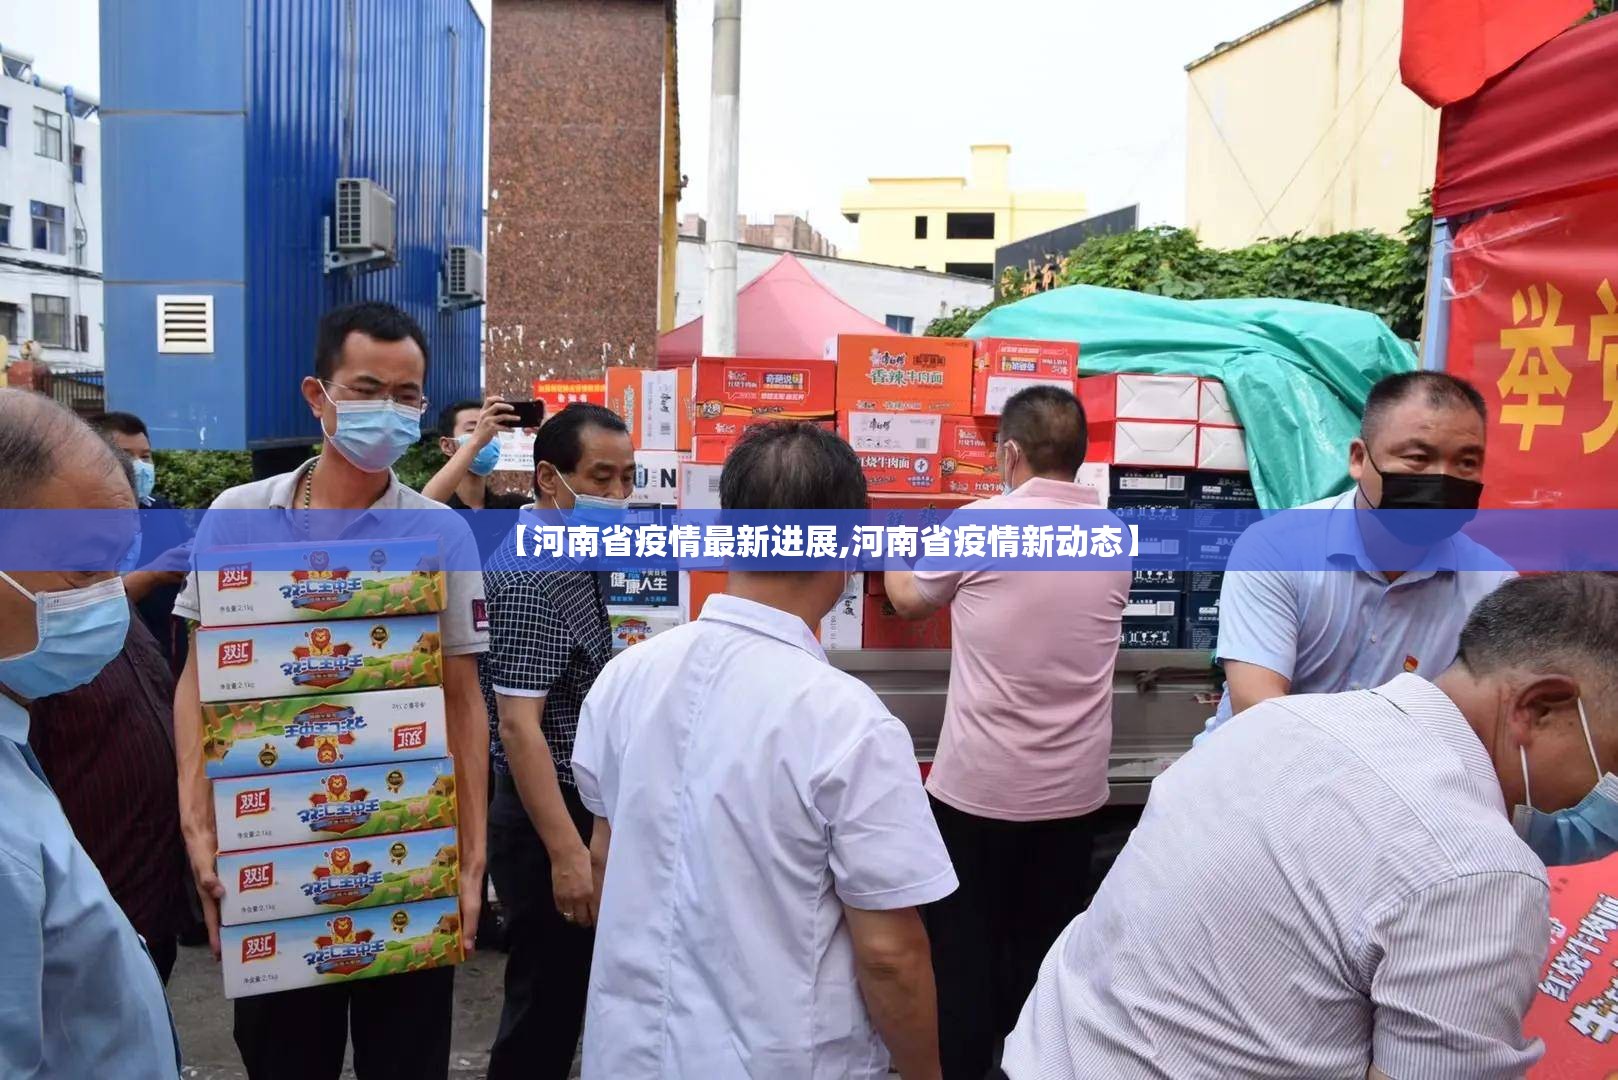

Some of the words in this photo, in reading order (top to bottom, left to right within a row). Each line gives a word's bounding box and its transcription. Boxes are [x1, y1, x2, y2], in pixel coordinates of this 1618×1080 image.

[867, 368, 944, 387] 香辣牛肉面
[222, 565, 249, 584] 双汇
[610, 571, 668, 594] 健康人生
[279, 577, 364, 600] 双汇王中王
[222, 642, 249, 662] 双汇
[280, 653, 364, 676] 双汇王中王
[284, 715, 368, 739] 双汇王中王
[397, 731, 423, 749] 双汇
[240, 792, 267, 811] 双汇
[297, 799, 380, 823] 双汇王中王
[243, 866, 270, 886] 双汇
[300, 871, 383, 896] 双汇王中王
[246, 936, 273, 956] 双汇
[303, 939, 385, 966] 双汇王中王
